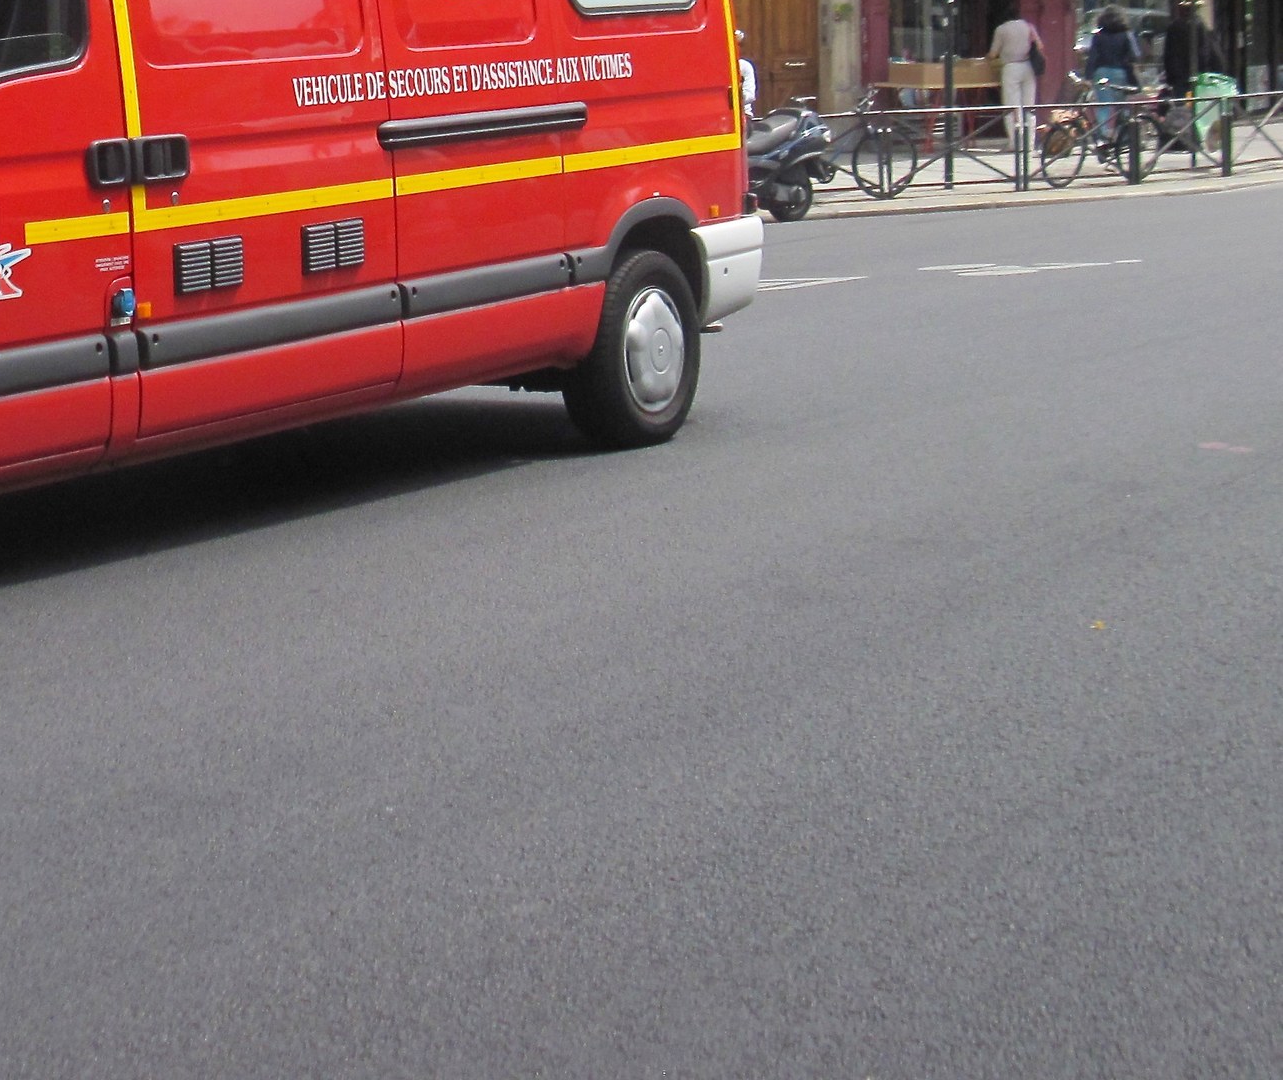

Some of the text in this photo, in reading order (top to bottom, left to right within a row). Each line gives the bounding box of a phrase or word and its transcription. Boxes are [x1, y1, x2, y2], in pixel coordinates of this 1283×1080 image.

[292, 53, 633, 107] VEHICULE DE SECOURS ET D'ASSISTANCE AUX VICTIMES
